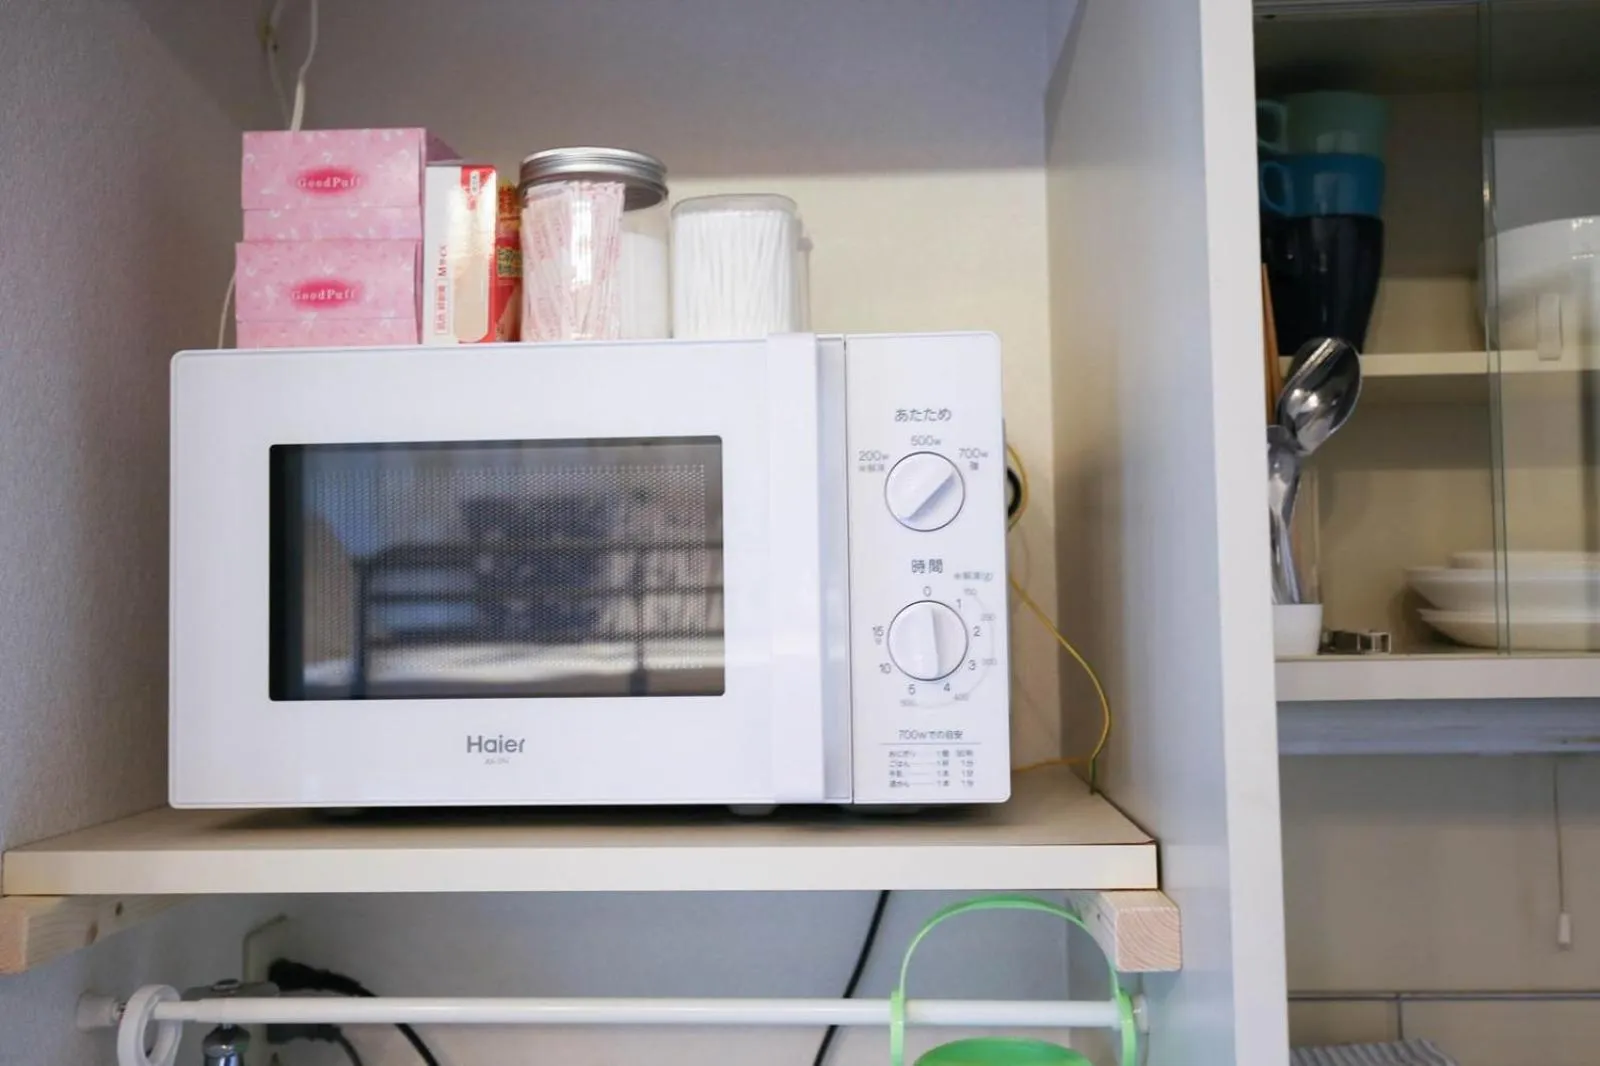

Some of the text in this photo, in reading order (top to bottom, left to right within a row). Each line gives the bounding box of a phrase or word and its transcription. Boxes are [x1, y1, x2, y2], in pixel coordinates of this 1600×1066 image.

[894, 407, 952, 422] あたため
[911, 558, 943, 574] 時間
[922, 585, 932, 598] 0
[956, 598, 962, 610] 1
[872, 625, 885, 637] 15
[972, 625, 981, 638] 2
[879, 662, 892, 675] 10
[968, 659, 977, 671] 3
[908, 684, 917, 696] 5
[943, 682, 951, 693] 4
[466, 735, 525, 753] Haier
